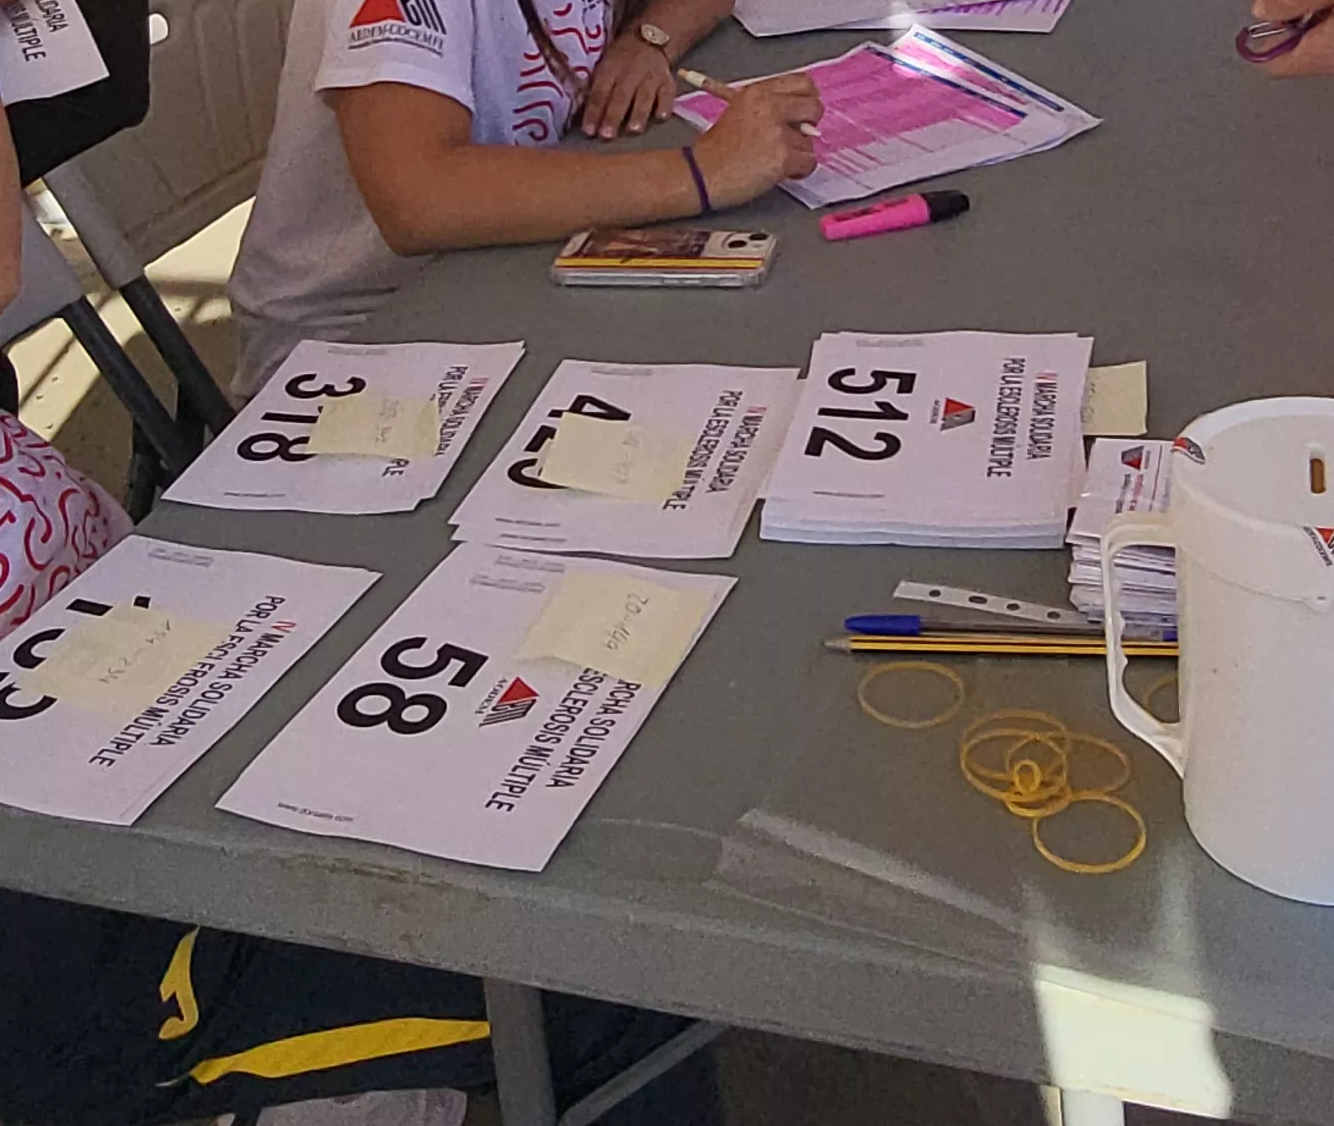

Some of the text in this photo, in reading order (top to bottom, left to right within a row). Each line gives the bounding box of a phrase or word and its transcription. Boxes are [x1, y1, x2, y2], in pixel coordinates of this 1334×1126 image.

[1003, 358, 1026, 374] POR
[237, 373, 366, 462] 318
[804, 367, 918, 461] 512
[236, 618, 260, 634] LA
[246, 595, 286, 618] POR
[219, 631, 283, 681] MARCHA
[337, 636, 489, 735] 58
[149, 682, 231, 747] SOLIDARIA
[546, 679, 642, 787] RCHA SOLIDARIA
[486, 745, 553, 811] MÚLTIPLE
